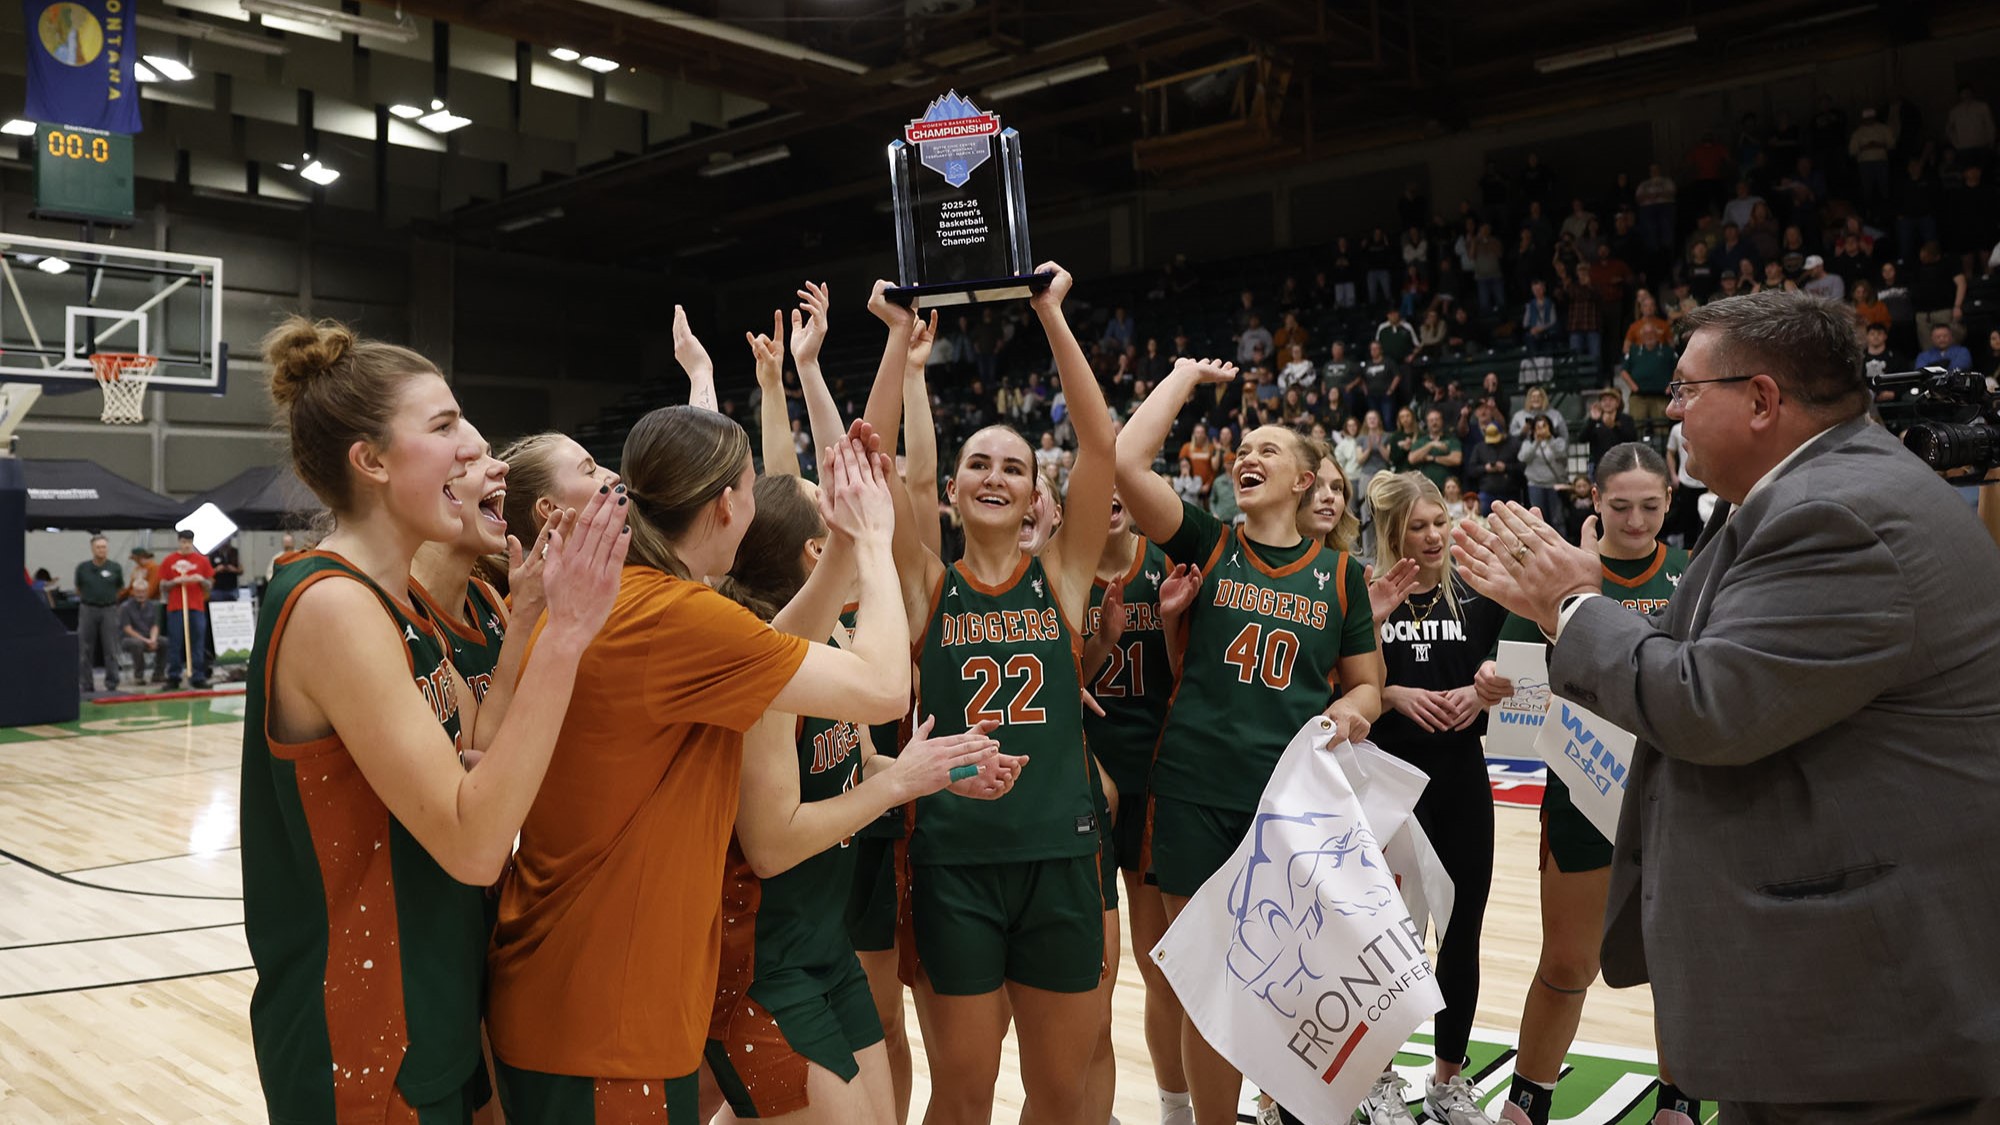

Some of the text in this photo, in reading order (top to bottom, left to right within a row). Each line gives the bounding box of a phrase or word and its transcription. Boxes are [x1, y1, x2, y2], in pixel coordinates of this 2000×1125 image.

[912, 123, 993, 140] CHAMPIONSHIP
[949, 118, 982, 126] BASKETBALL
[48, 131, 109, 163] 00.0
[940, 208, 981, 219] Women's
[941, 199, 978, 210] 2025-26
[936, 225, 989, 238] Tournament
[939, 216, 984, 229] Basketball
[941, 235, 985, 247] Champion
[1213, 578, 1328, 631] DIGGERS
[941, 606, 1060, 647] DIGGERS
[1422, 620, 1439, 641] IT
[1441, 620, 1467, 642] IN.
[1224, 622, 1300, 691] 40
[1095, 641, 1145, 697] 21
[961, 653, 1047, 728] 22
[1560, 703, 1630, 792] WIN
